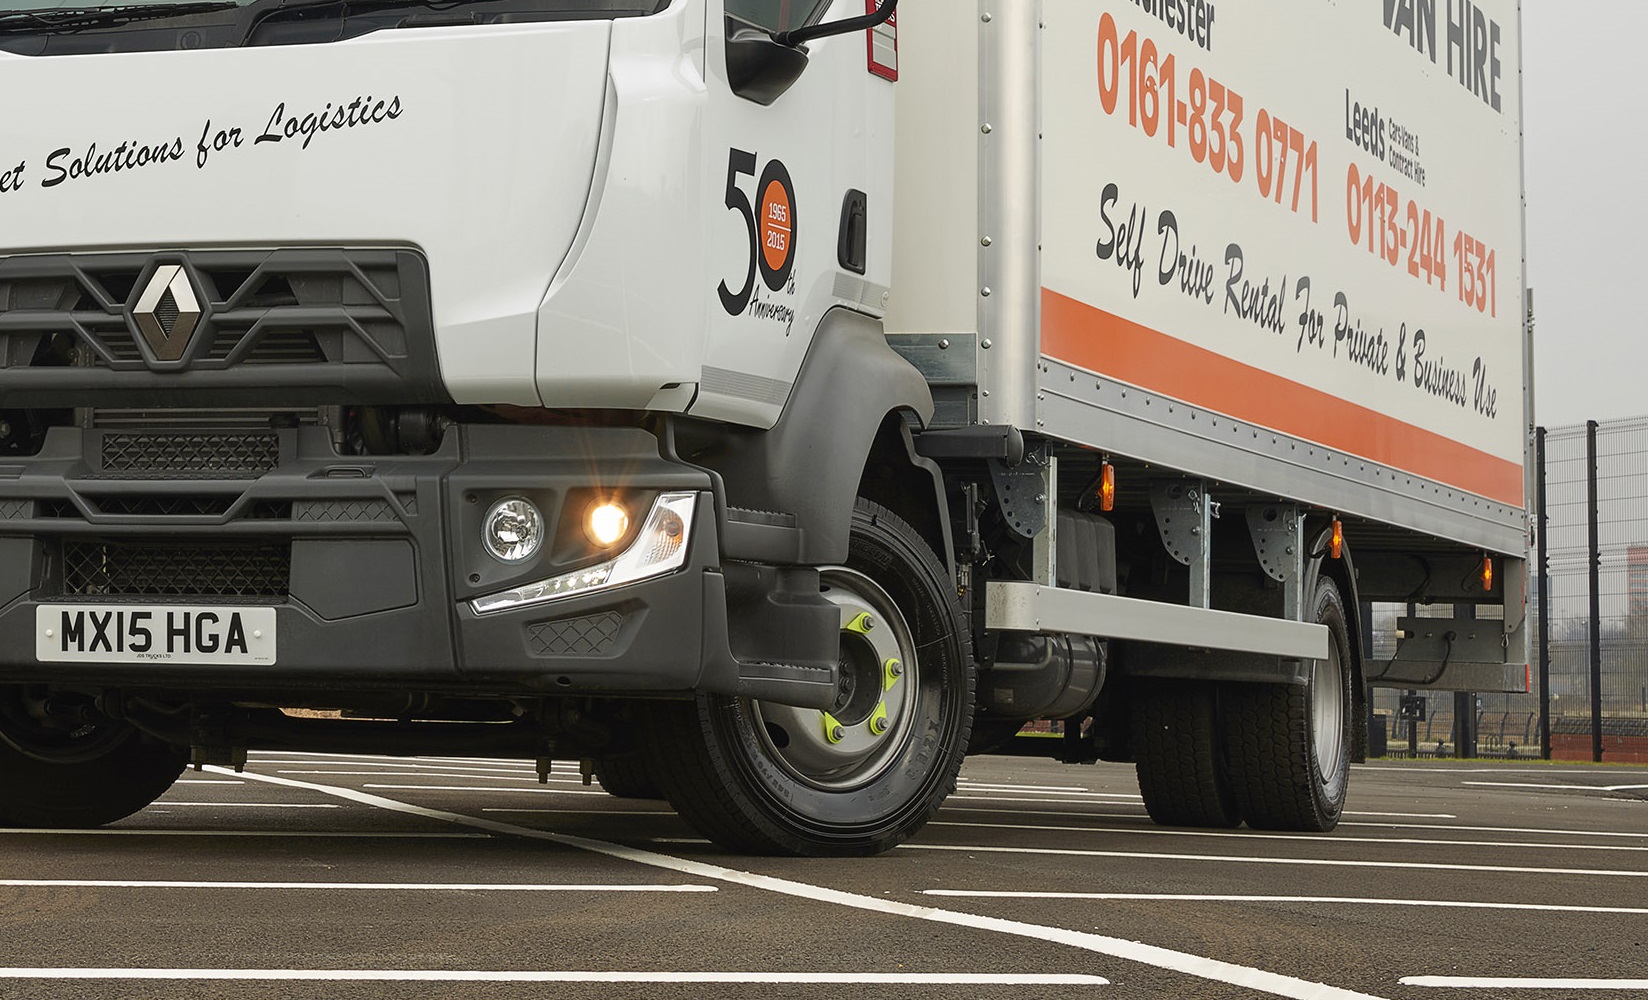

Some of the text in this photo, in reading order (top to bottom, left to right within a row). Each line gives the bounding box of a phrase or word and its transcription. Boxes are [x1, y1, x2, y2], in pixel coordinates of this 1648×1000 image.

[41, 137, 184, 187] Solutions
[197, 120, 244, 168] for
[254, 96, 403, 149] Logistics
[1097, 12, 1318, 223] 0161-833 0771
[1345, 88, 1385, 161] Leeds
[767, 230, 785, 250] 2015
[768, 202, 786, 222] 1965
[1346, 162, 1496, 317] 0113-244 1531
[750, 284, 794, 336] Anniversary
[1096, 183, 1497, 419] Self Drive Rental For Private & Business Use
[61, 611, 248, 653] MX15 HGA
